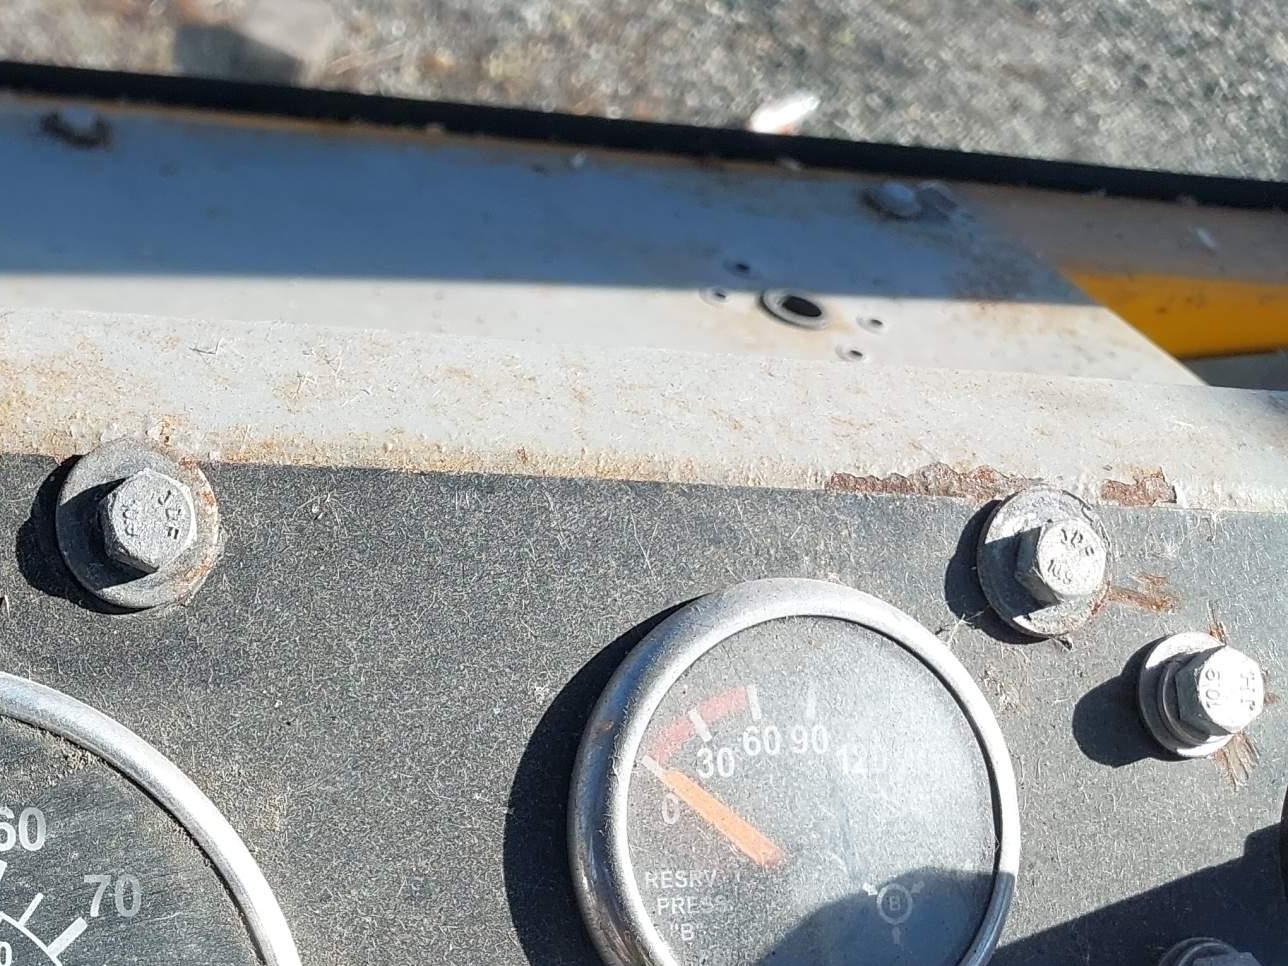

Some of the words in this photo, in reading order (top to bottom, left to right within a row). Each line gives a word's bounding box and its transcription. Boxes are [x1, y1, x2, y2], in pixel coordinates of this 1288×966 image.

[742, 726, 781, 756] 60
[790, 725, 829, 755] 90
[697, 747, 735, 779] 30
[662, 792, 680, 825] 0
[84, 874, 142, 918] 70
